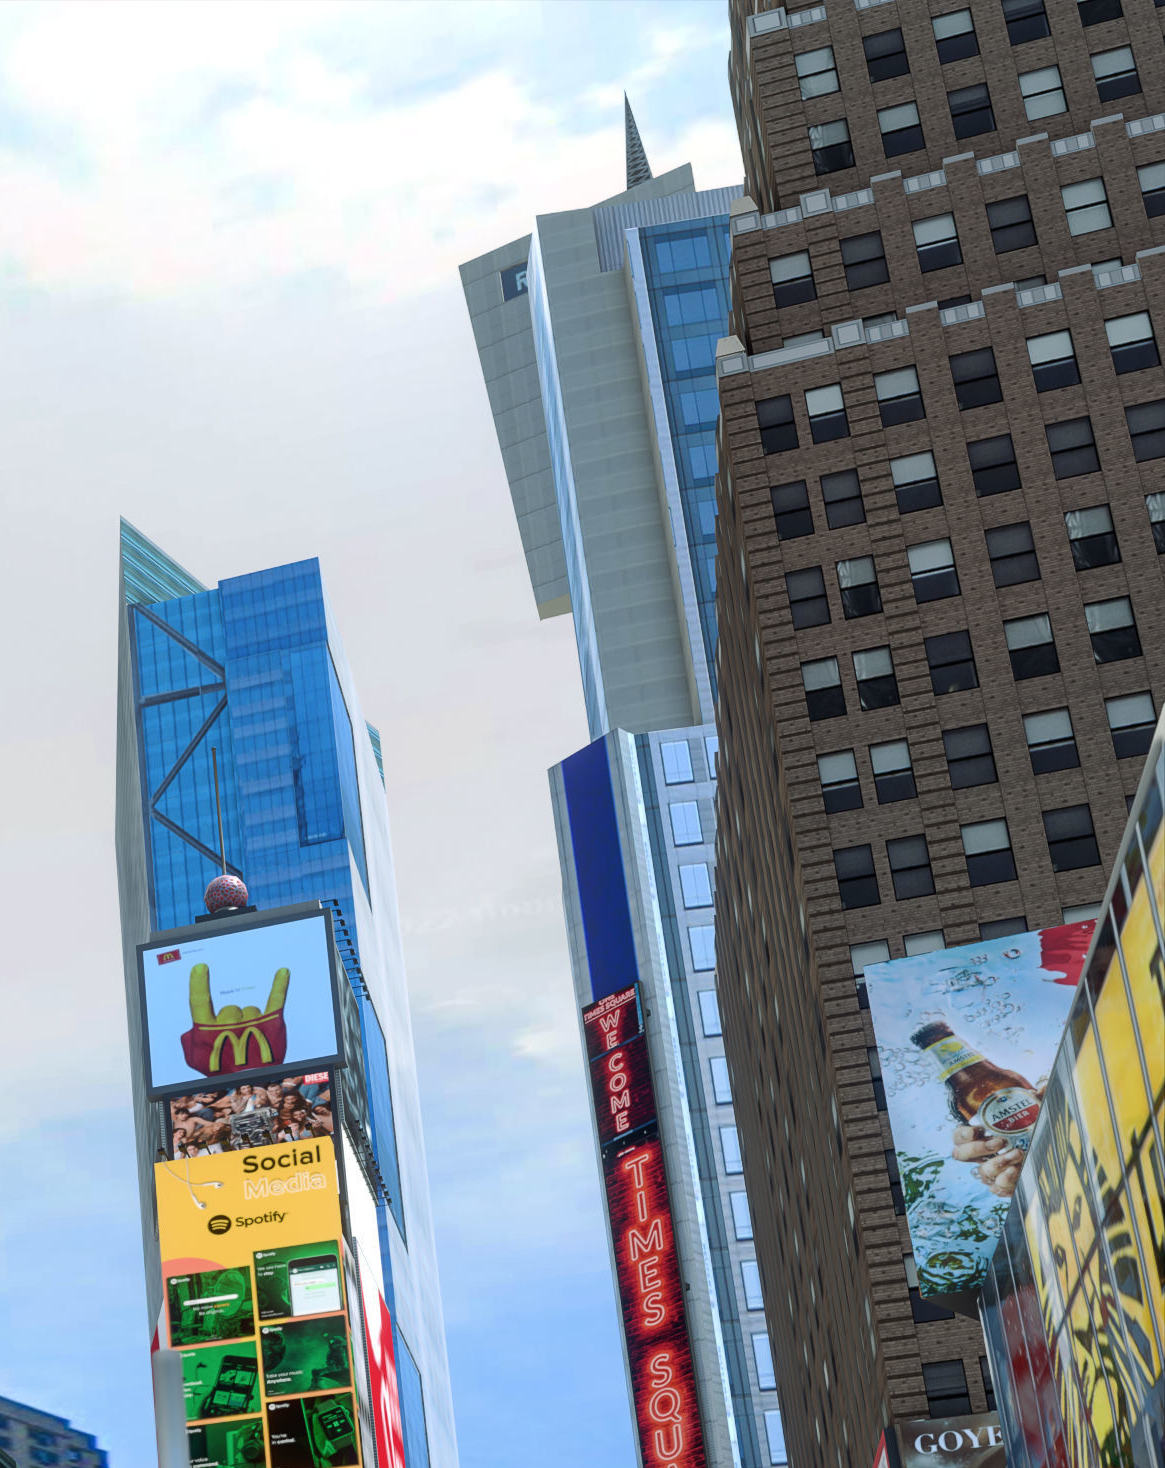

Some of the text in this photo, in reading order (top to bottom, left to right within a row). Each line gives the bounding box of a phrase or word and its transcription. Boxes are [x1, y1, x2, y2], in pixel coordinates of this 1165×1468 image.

[584, 988, 636, 1022] TIMES SQUARE
[991, 1098, 1034, 1122] AMSTEL
[242, 1145, 322, 1174] Social
[244, 1171, 328, 1201] Media
[235, 1211, 287, 1228] Spotify
[624, 1153, 666, 1328] TIMES
